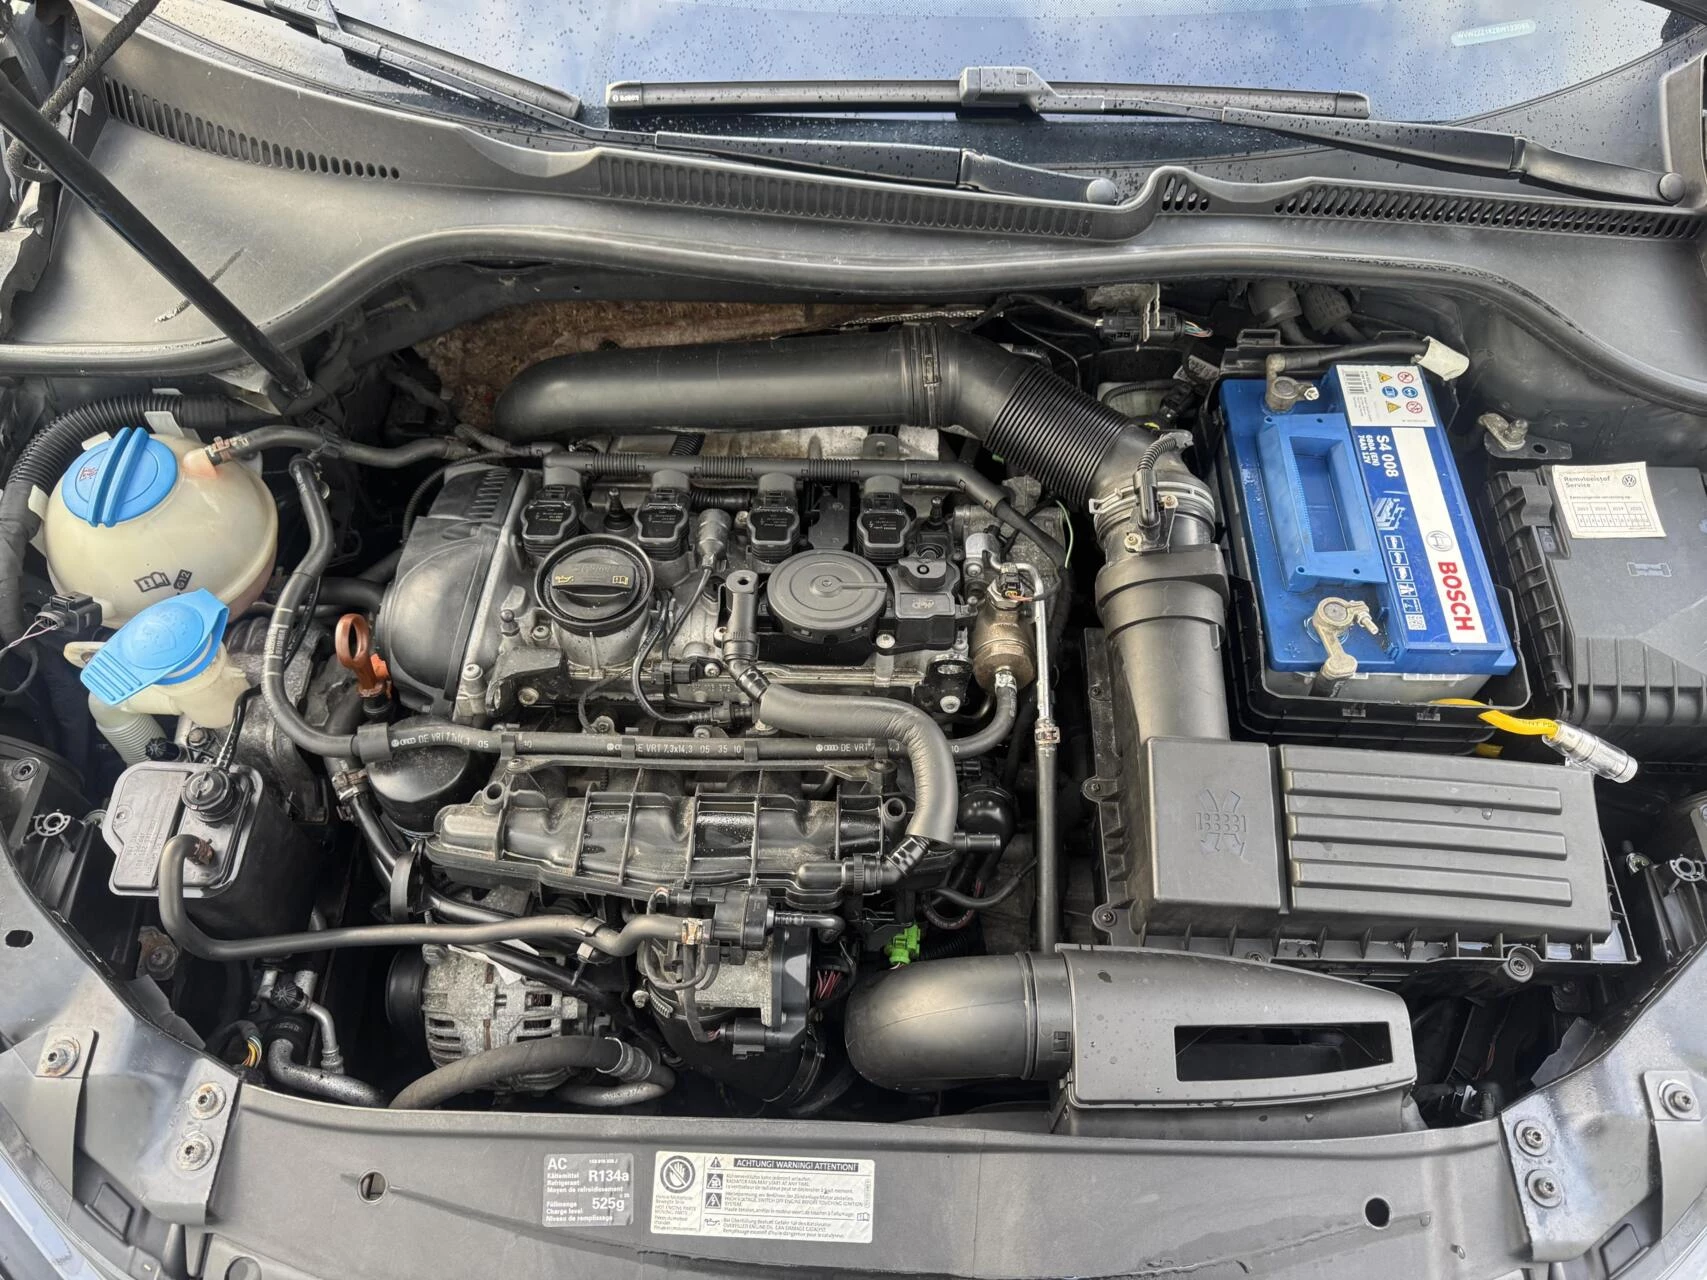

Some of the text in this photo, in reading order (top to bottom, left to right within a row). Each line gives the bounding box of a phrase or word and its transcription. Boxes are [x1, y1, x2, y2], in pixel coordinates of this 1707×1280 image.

[1377, 435, 1399, 477] S4 008
[1438, 562, 1475, 630] BOSCH
[700, 745, 710, 754] 05
[718, 745, 728, 754] 35
[841, 744, 850, 752] DE
[547, 1157, 568, 1170] AC
[736, 1159, 856, 1171] ACHTUNG! WARNING! ATTENTION!
[588, 1169, 630, 1182] R134a
[592, 1197, 625, 1212] 525g
